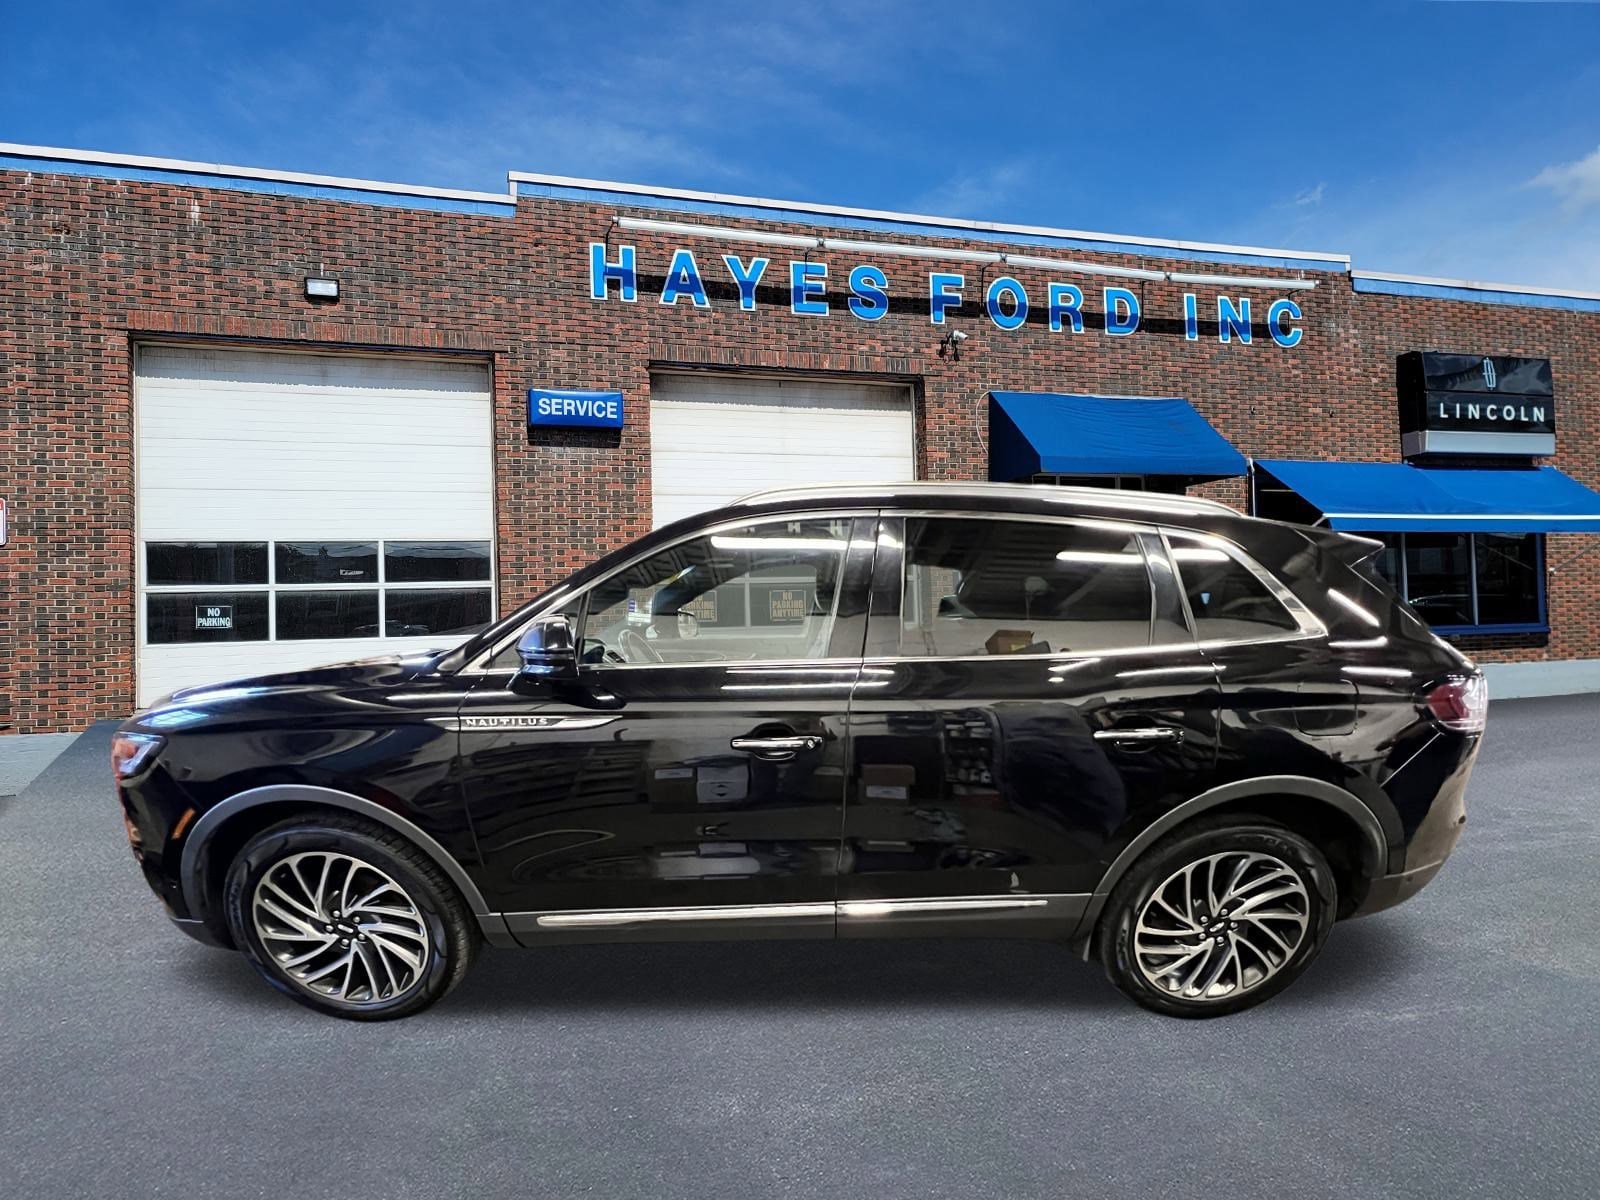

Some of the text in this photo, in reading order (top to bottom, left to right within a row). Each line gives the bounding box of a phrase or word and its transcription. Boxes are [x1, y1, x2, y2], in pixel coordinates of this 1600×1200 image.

[589, 242, 1304, 348] HAYES FORD INC
[538, 397, 618, 419] SERVICE
[1439, 402, 1545, 422] LINCOLN
[207, 607, 220, 616] NO
[198, 617, 231, 627] PARKING
[465, 717, 549, 726] NAUTILUS
